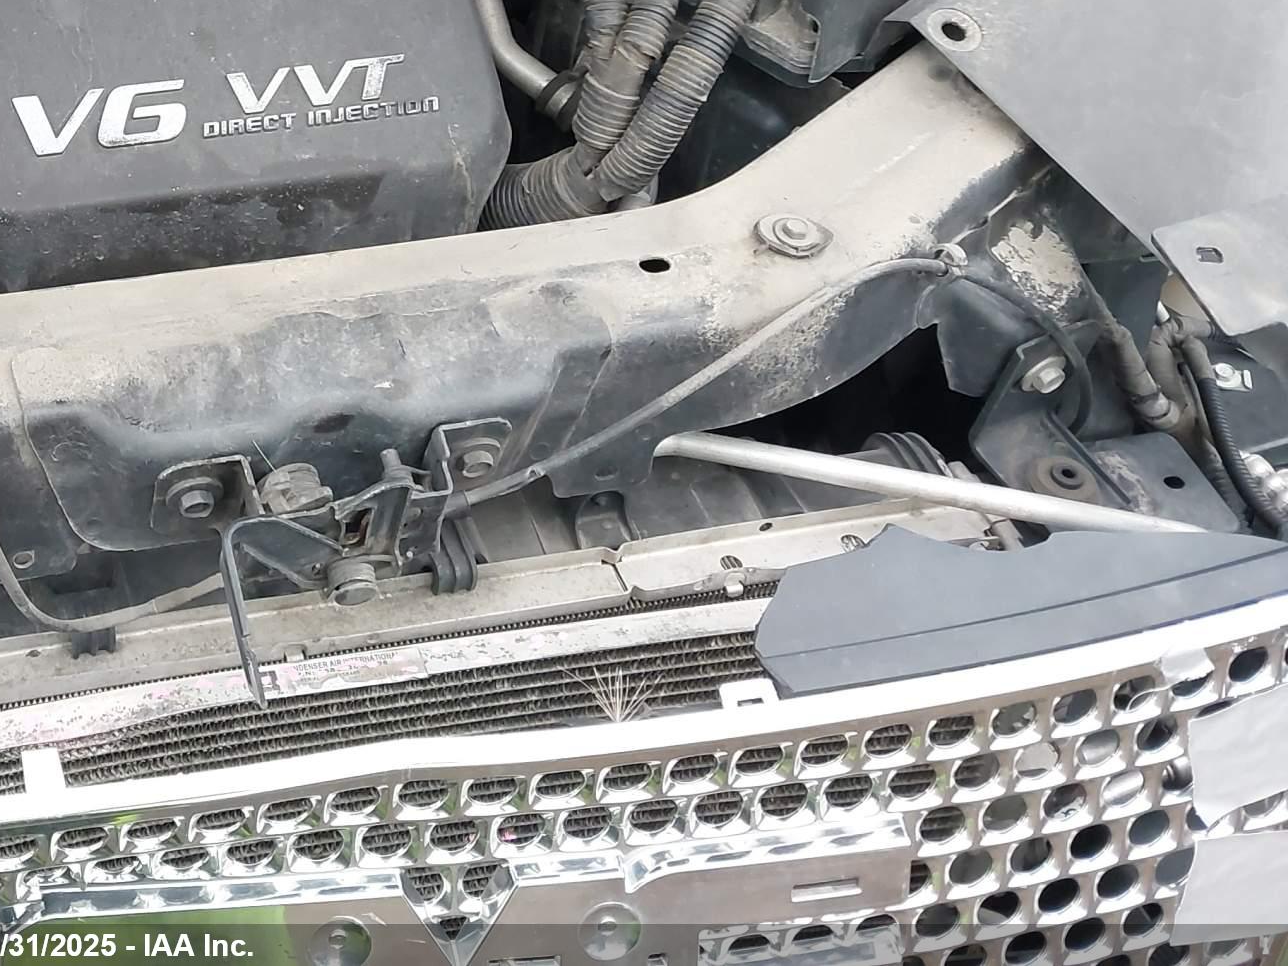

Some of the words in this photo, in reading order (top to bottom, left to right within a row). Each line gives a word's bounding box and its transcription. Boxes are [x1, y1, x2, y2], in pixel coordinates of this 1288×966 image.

[12, 79, 187, 157] V6
[225, 53, 405, 115] VVT
[202, 112, 296, 139] DIRECT
[307, 96, 440, 126] INJECTION
